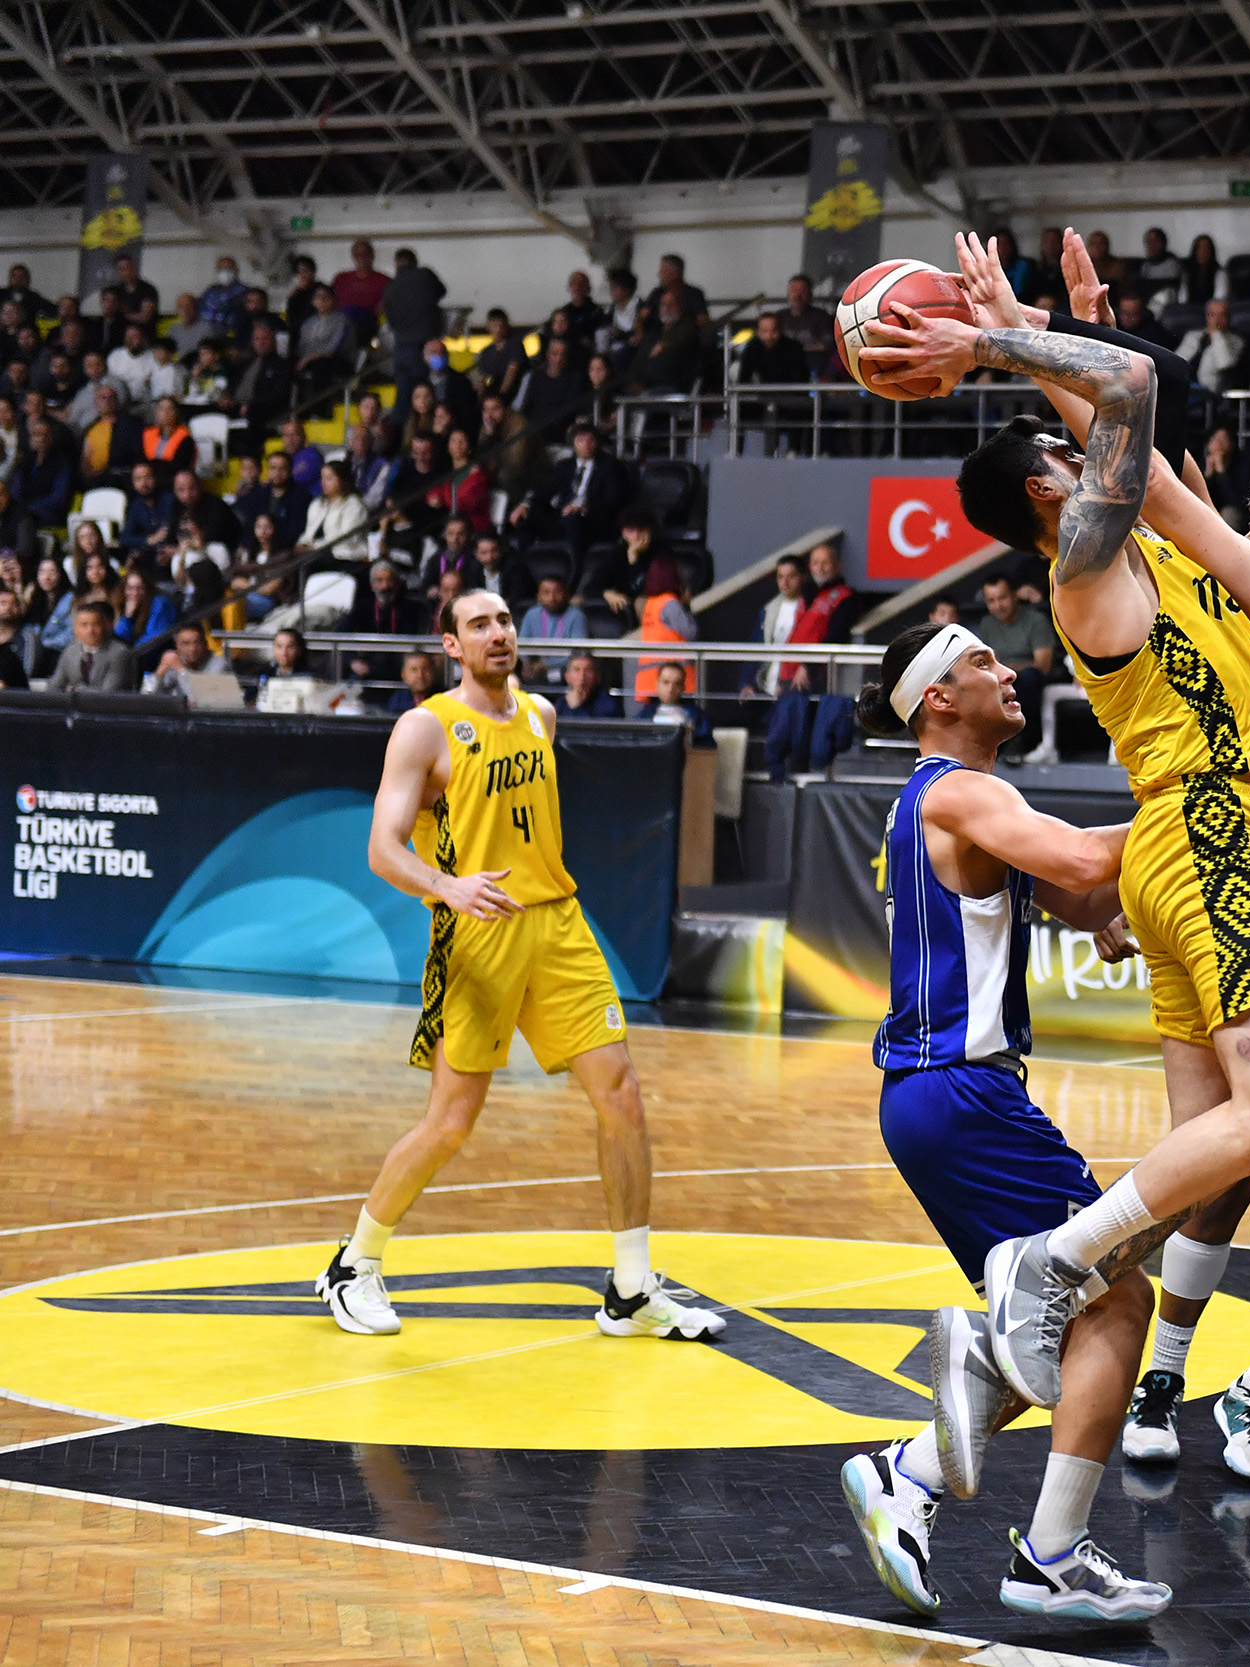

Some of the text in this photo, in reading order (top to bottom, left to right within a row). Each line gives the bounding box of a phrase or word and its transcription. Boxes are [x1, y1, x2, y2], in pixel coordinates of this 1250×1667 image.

[486, 750, 546, 798] MSK
[16, 813, 115, 848] TÜRKİYE
[14, 843, 153, 878] BASKETBOL
[13, 869, 58, 900] LİGİ
